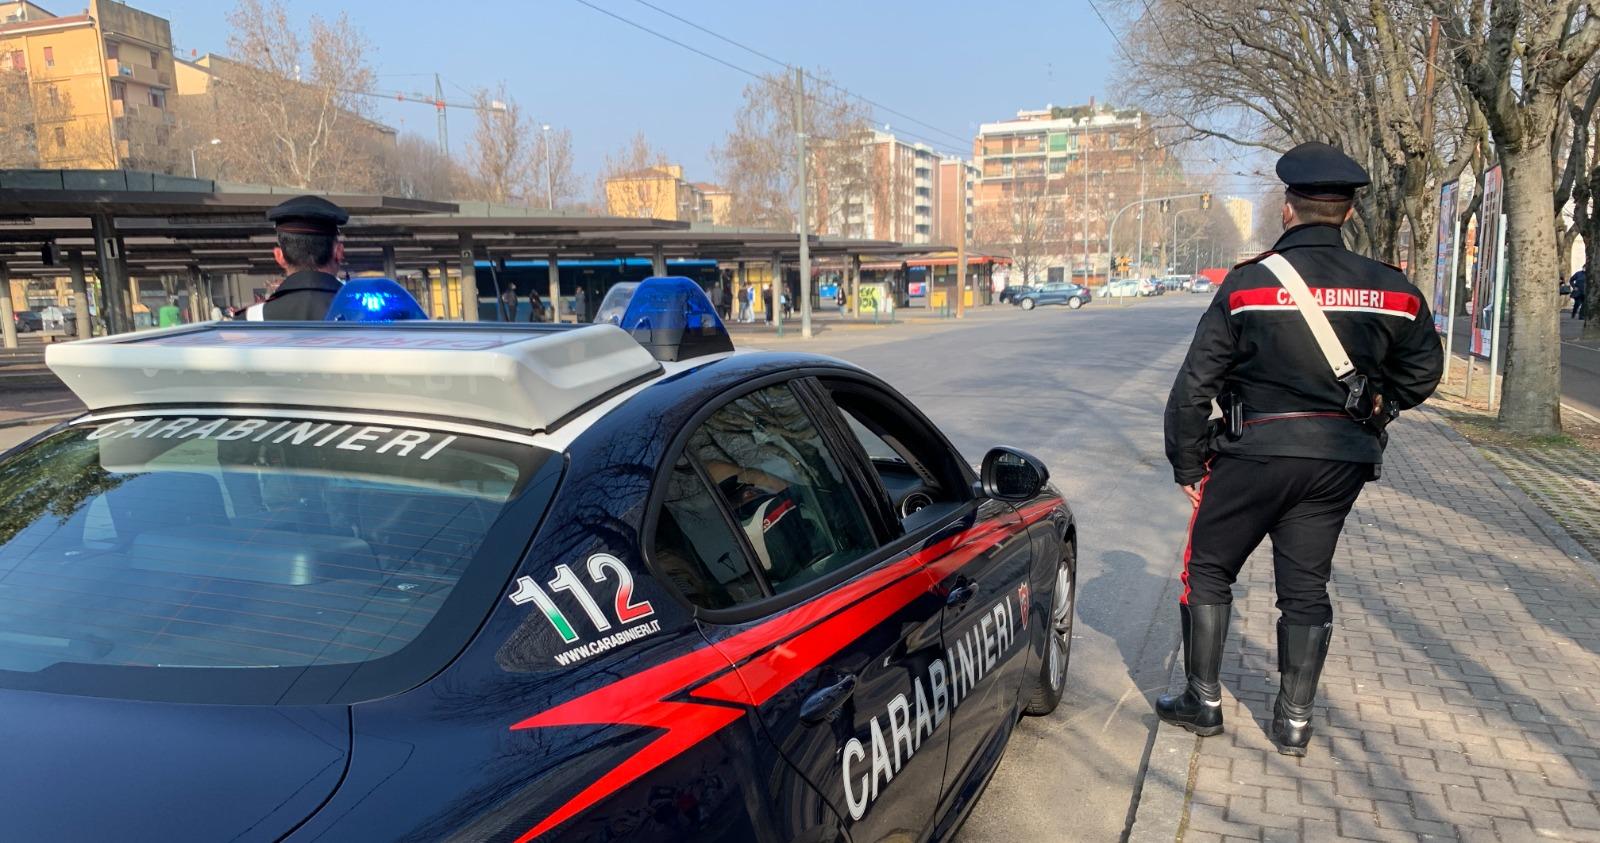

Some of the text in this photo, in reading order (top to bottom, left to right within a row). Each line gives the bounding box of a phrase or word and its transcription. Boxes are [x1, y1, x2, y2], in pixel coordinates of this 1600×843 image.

[107, 239, 115, 258] 1
[1276, 288, 1384, 308] CABINIERI
[87, 417, 458, 460] CARABINIERI
[509, 553, 655, 644] 112
[554, 619, 661, 666] WWW.CARABINIERI.IT
[842, 595, 1014, 821] CARABINIERI
